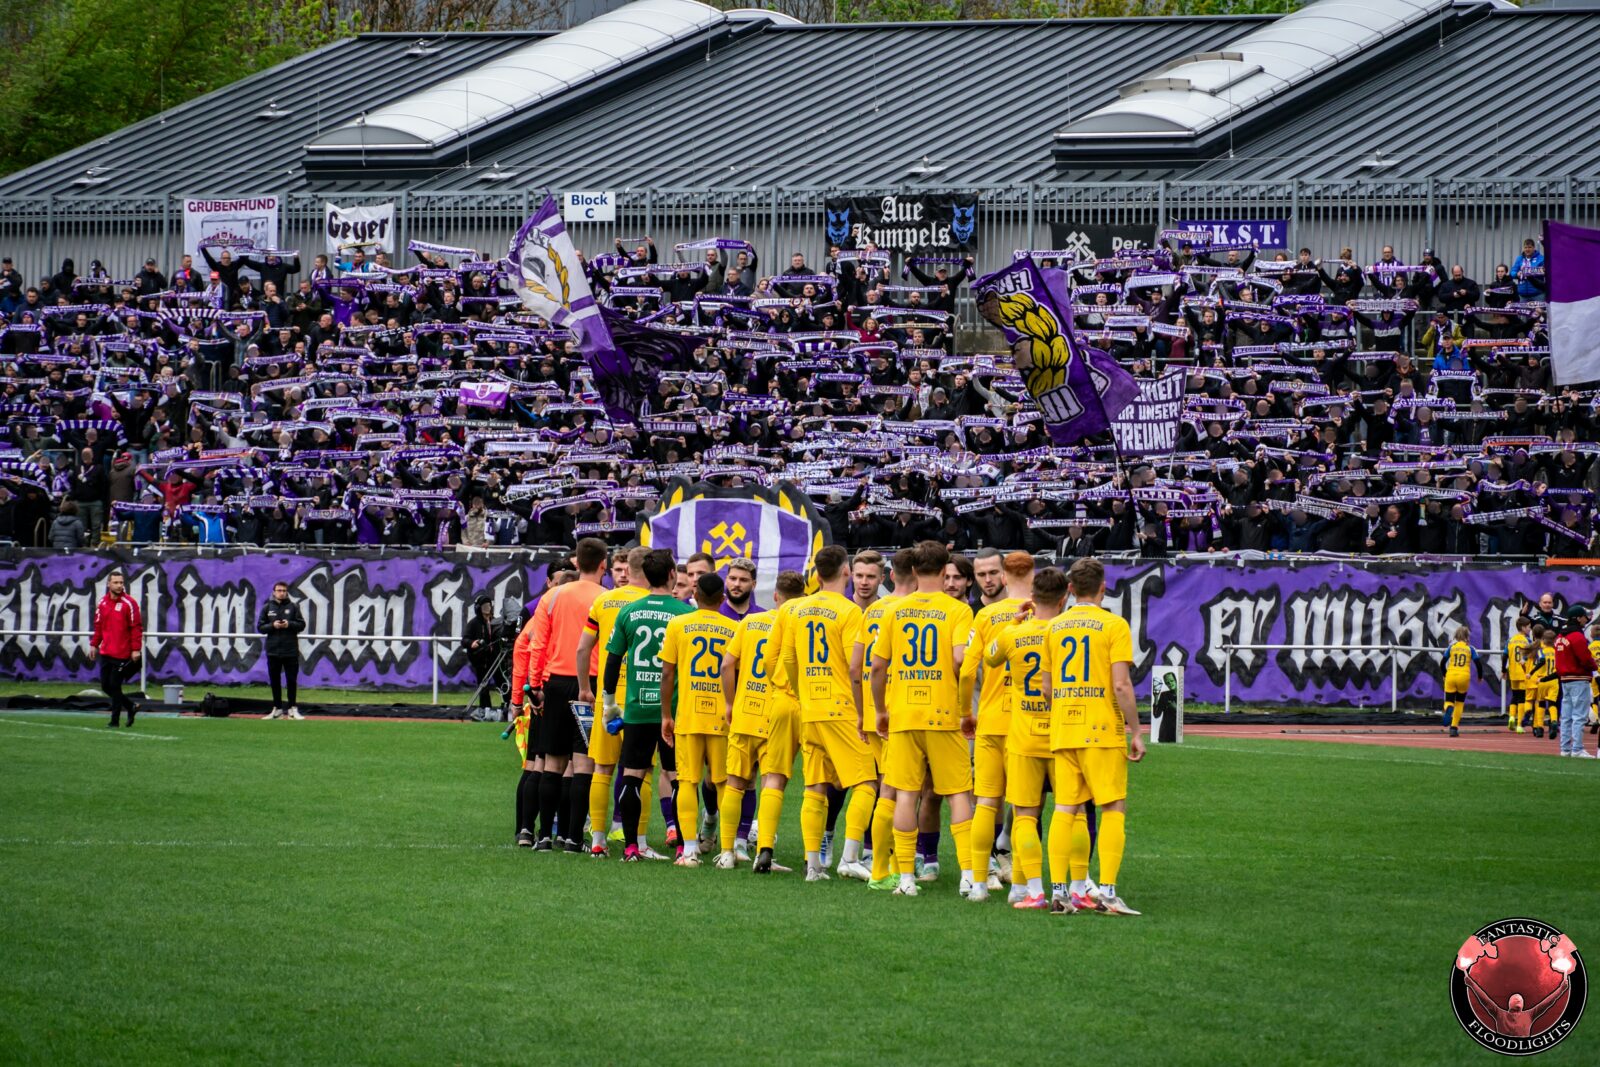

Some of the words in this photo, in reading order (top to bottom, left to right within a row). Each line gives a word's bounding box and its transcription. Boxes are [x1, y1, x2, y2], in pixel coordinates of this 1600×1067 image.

[188, 198, 276, 212] GRUBENHUND
[571, 194, 608, 206] Block
[585, 208, 595, 219] C
[881, 196, 924, 223] Aue
[327, 211, 389, 243] Geyer
[851, 221, 952, 252] Kumpels
[1138, 400, 1181, 421] UNSER
[1110, 420, 1179, 451] FREUND
[979, 485, 1014, 496] COMPANY
[895, 607, 947, 621] BISCHOFSWERDA
[683, 623, 735, 638] BISCHOFSWERDA
[1052, 619, 1105, 633] BISCHOFSWERDA
[633, 625, 666, 668] 23
[805, 620, 829, 664] 13
[902, 622, 938, 668] 30
[690, 636, 726, 679] 25
[1060, 635, 1091, 683] 21
[1453, 653, 1467, 668] 10
[635, 671, 662, 682] KIEFE
[690, 681, 722, 693] MIGUEL
[746, 680, 768, 693] SOBE
[1067, 709, 1082, 717] PTH
